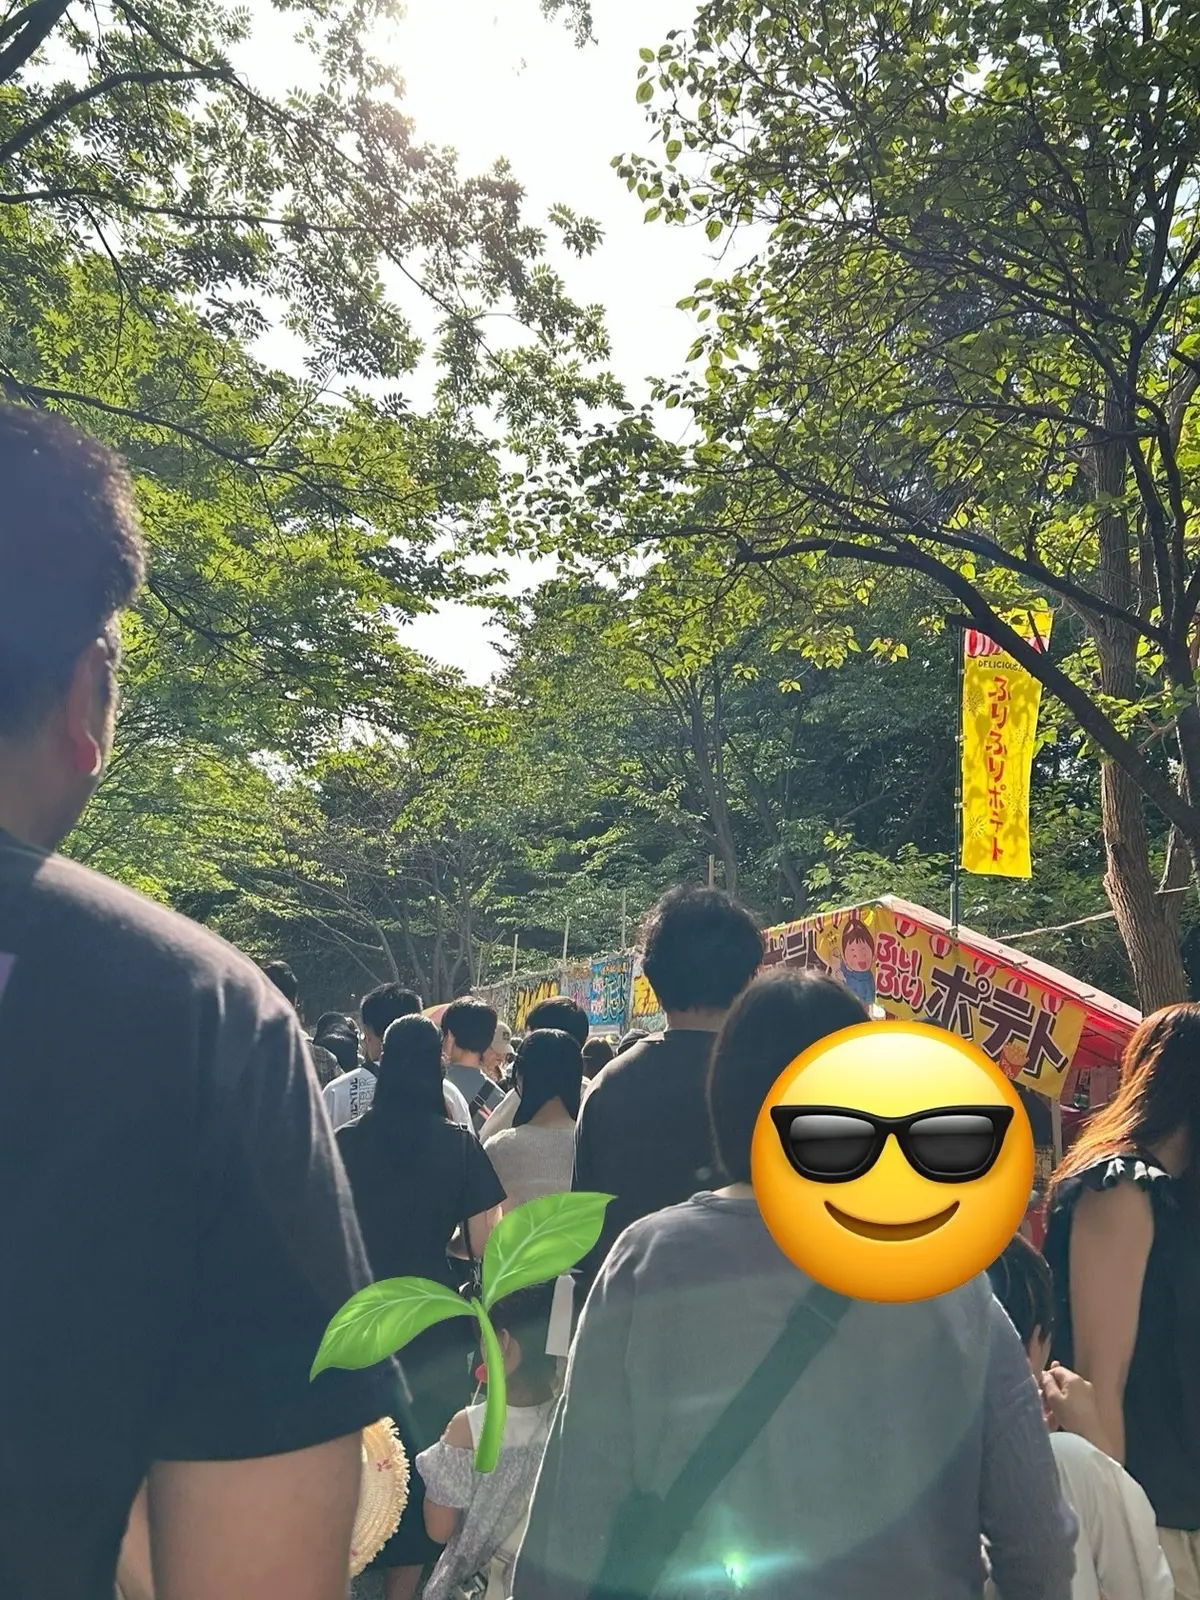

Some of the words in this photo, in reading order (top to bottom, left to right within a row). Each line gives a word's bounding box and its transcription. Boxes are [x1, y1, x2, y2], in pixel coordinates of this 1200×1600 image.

[986, 676, 1011, 862] ふりふりポテト
[924, 964, 1067, 1075] ポテト
